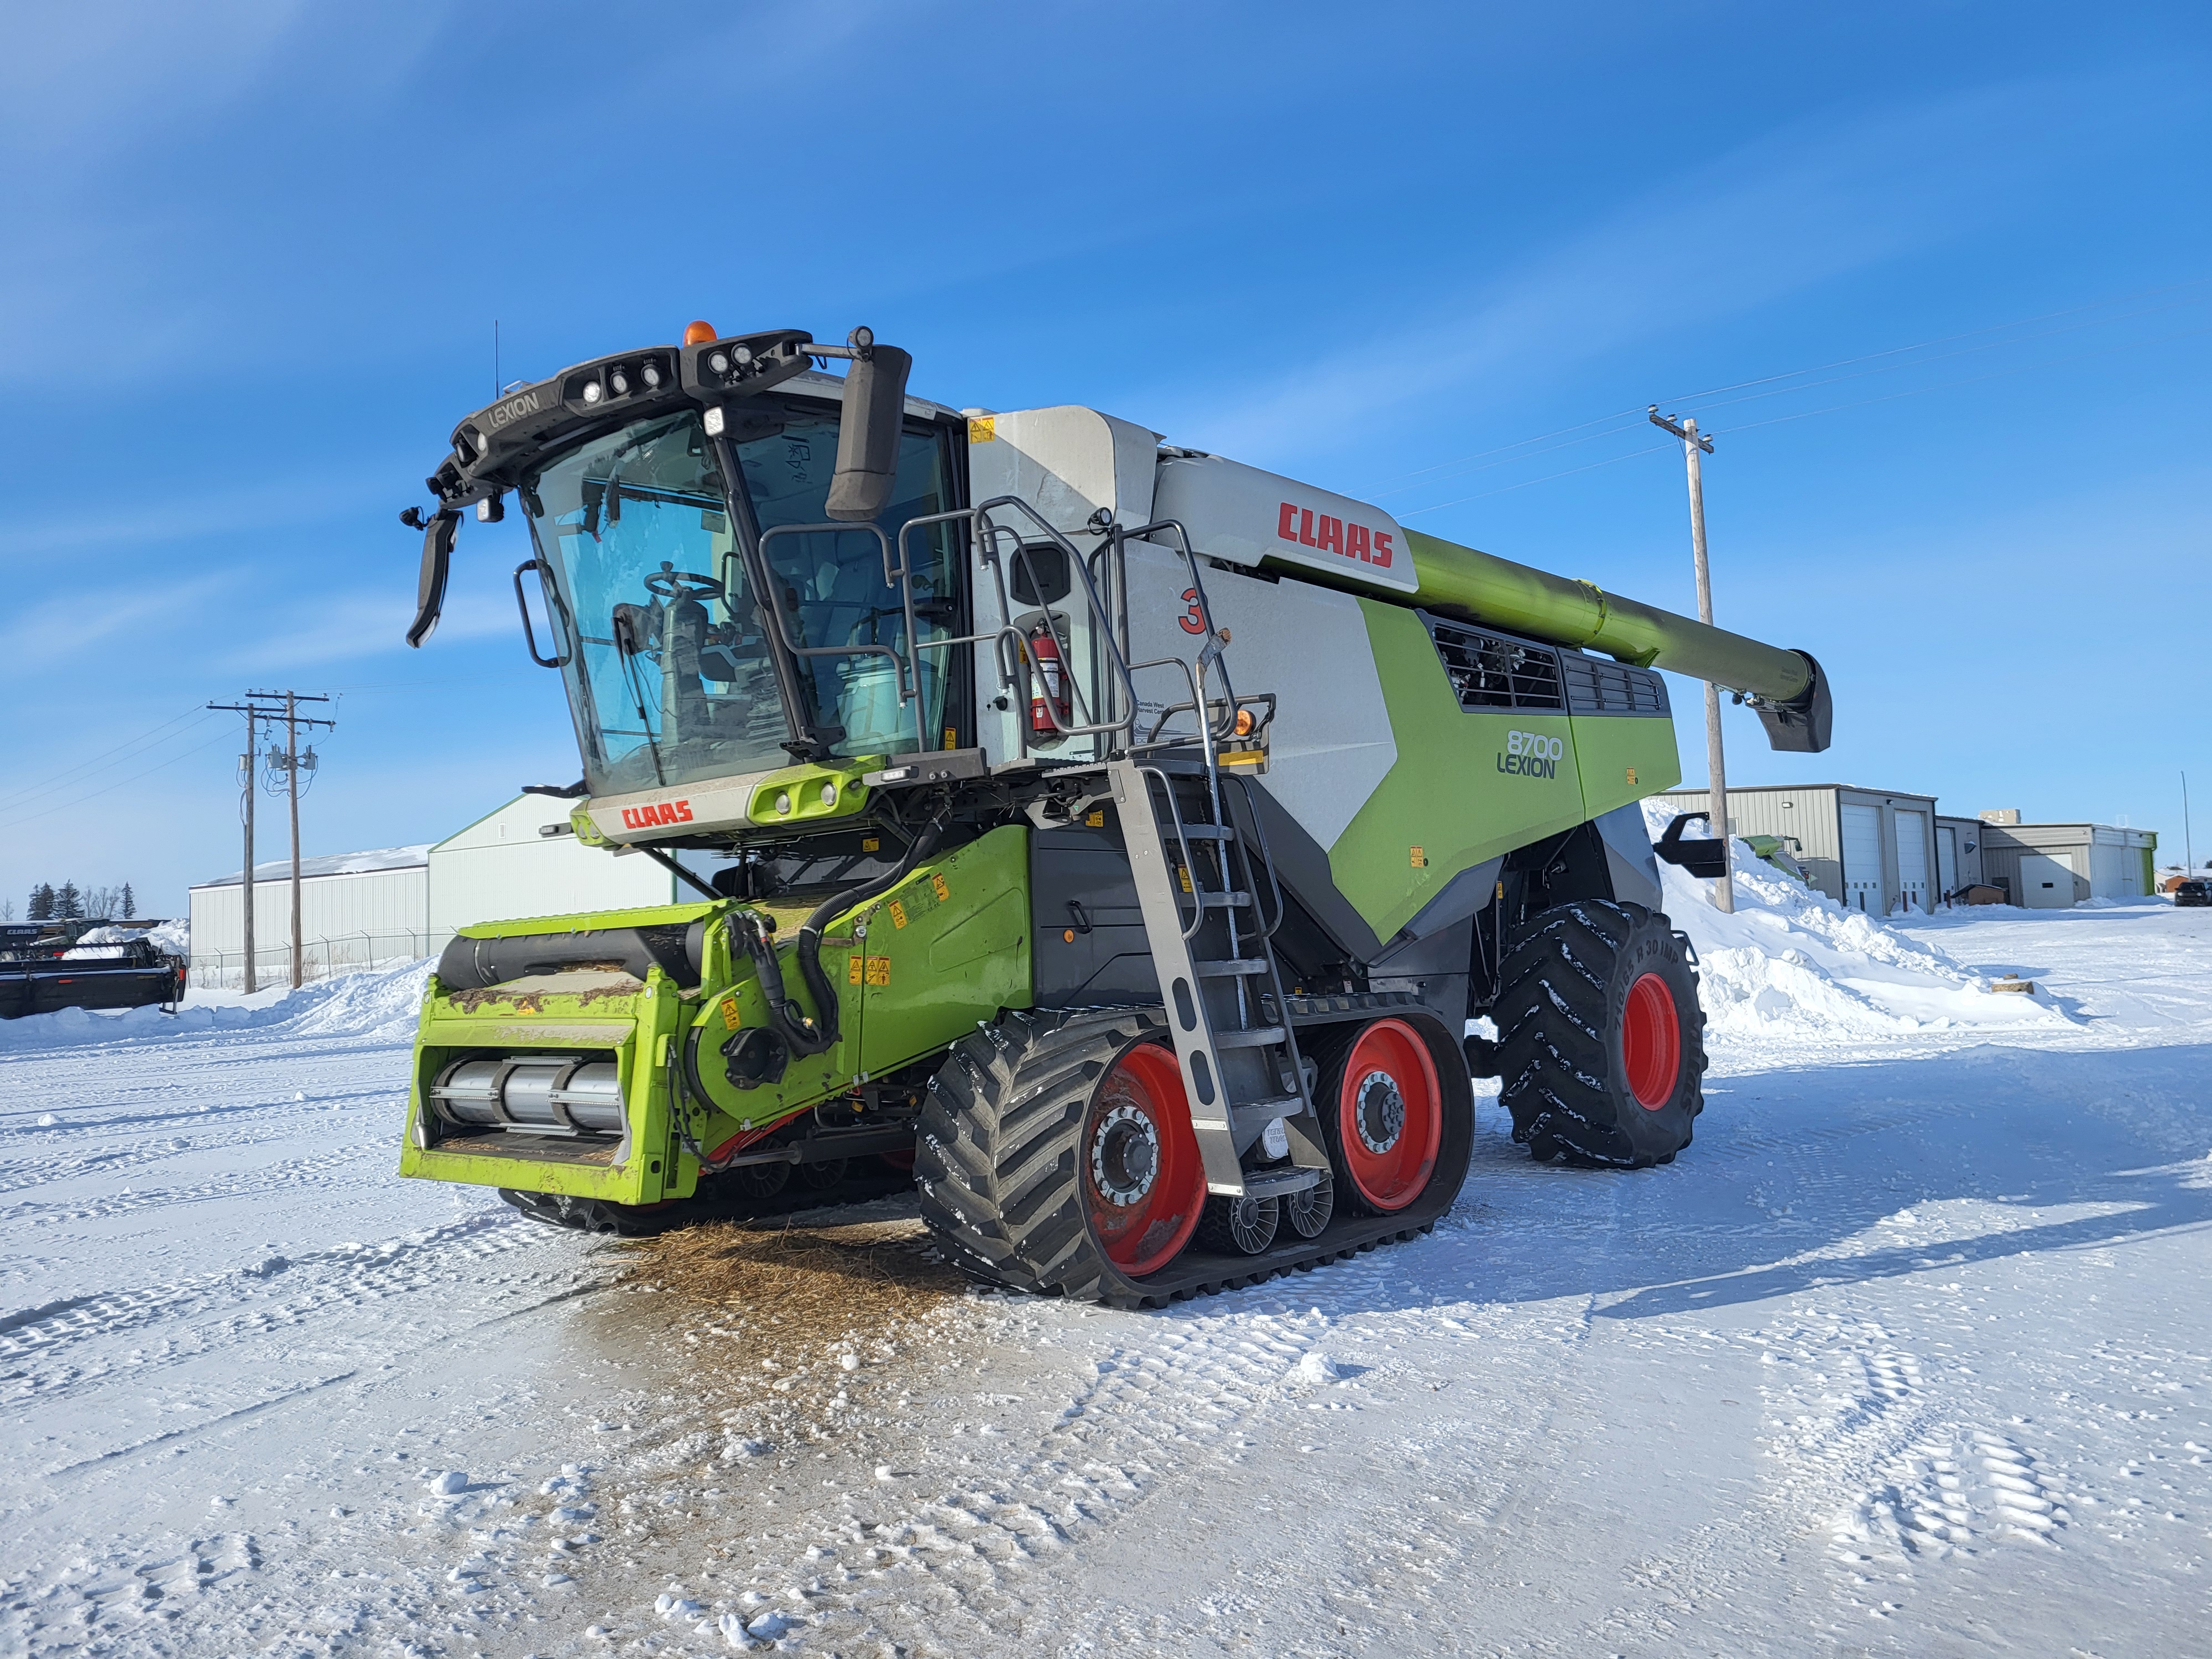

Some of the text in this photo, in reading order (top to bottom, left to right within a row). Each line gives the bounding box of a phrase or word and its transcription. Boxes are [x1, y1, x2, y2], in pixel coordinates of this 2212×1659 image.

[488, 392, 539, 428] LEXION
[1278, 502, 1392, 568] CLAAS
[1178, 587, 1208, 635] 3
[1507, 730, 1562, 760] 8700
[1496, 752, 1555, 780] LEXION
[621, 800, 693, 829] CLAAS
[1615, 958, 1634, 1030] 710/65
[1636, 945, 1644, 963] R
[1646, 939, 1658, 956] 30
[1267, 1128, 1285, 1136] TERR
